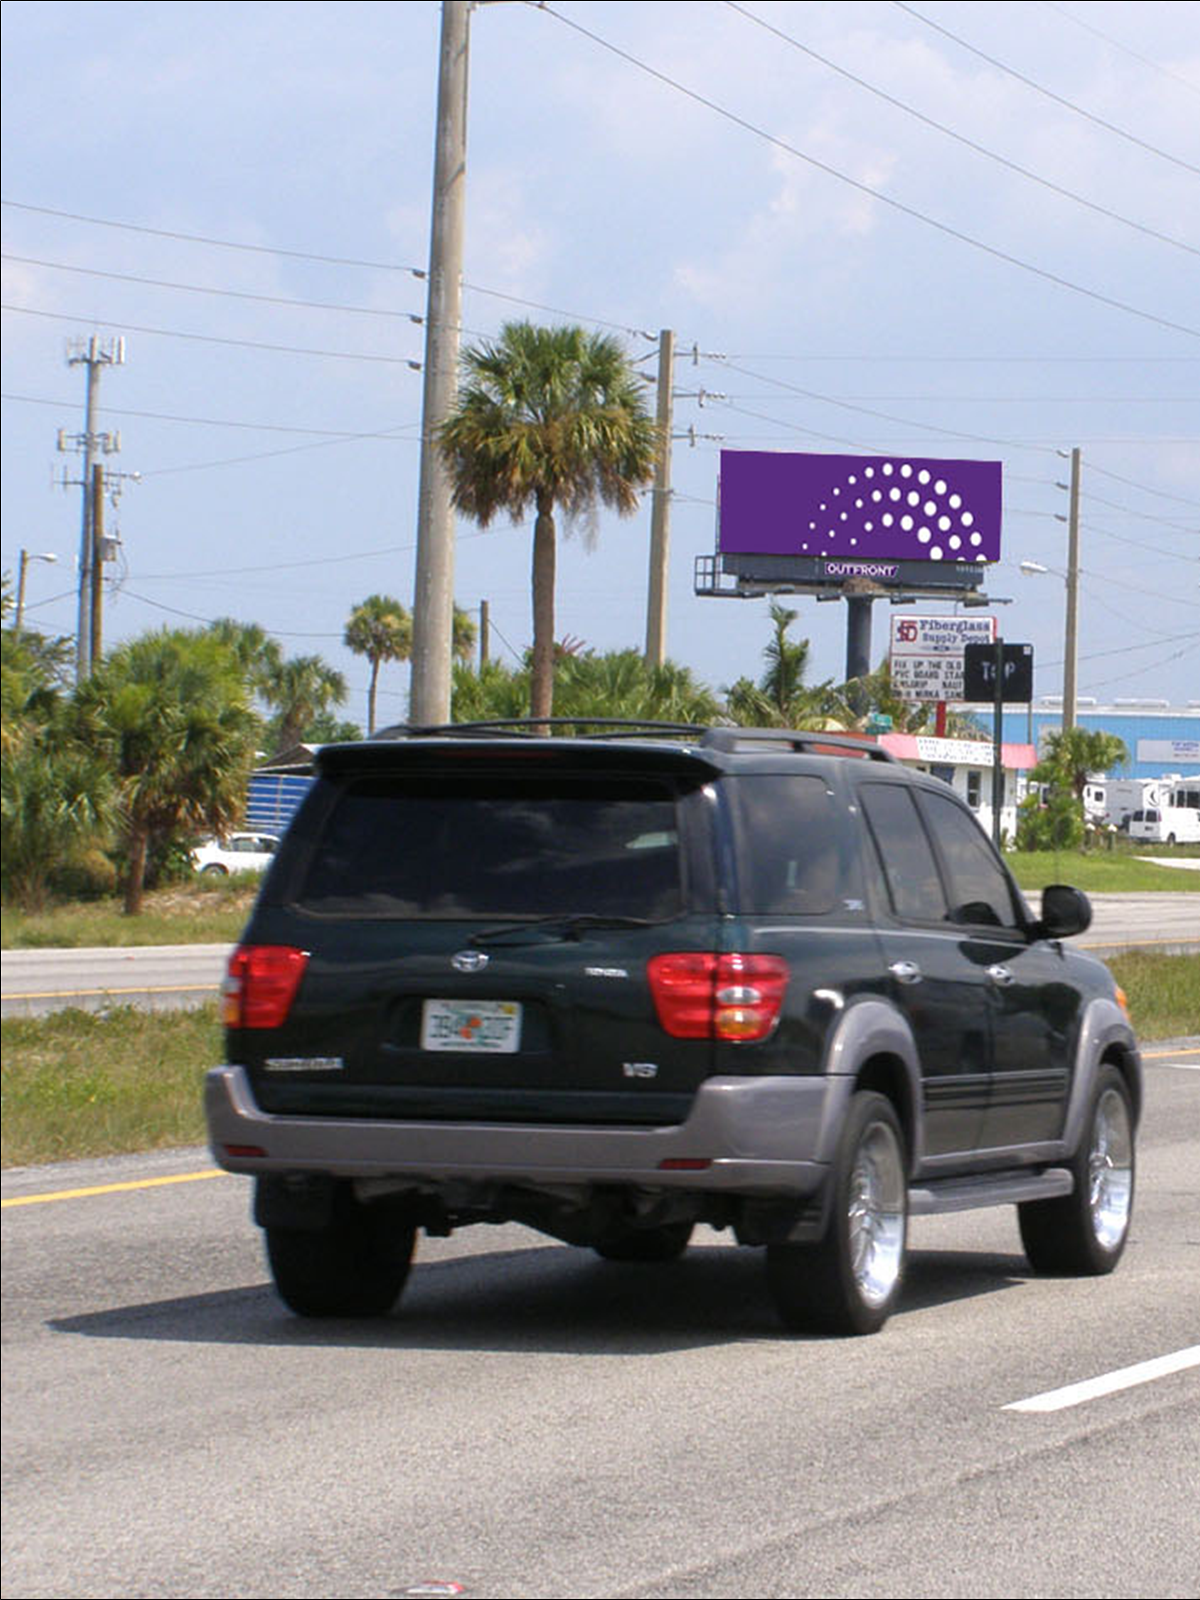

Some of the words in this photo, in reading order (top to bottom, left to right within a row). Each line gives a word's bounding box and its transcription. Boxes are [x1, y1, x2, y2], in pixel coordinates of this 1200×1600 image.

[826, 563, 895, 576] OUTFRONT
[919, 620, 990, 632] Fiberglass
[922, 632, 958, 643] Supply
[961, 634, 990, 645] Depot
[913, 660, 924, 669] UP
[928, 661, 942, 670] THE
